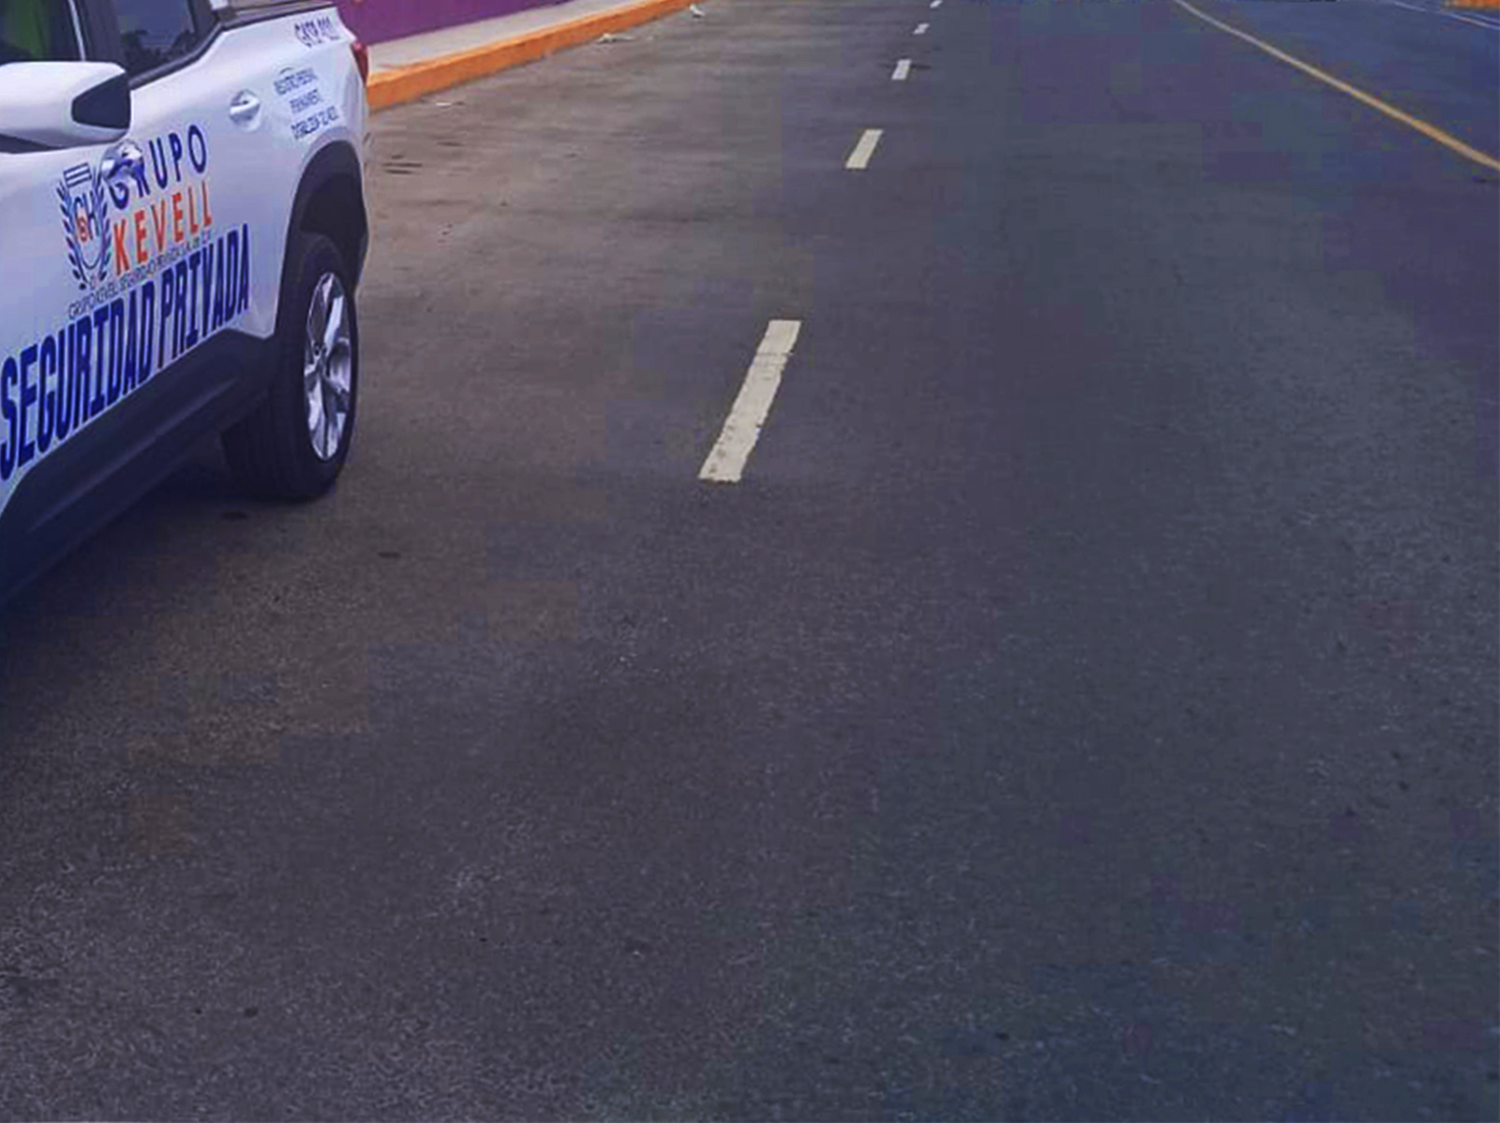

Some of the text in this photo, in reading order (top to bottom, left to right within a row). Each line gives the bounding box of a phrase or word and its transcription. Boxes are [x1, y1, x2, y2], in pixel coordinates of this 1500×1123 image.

[107, 125, 207, 210] GRUPO
[114, 181, 212, 276] KEVELL
[0, 223, 249, 481] SEGURIDAD PRIVADA
